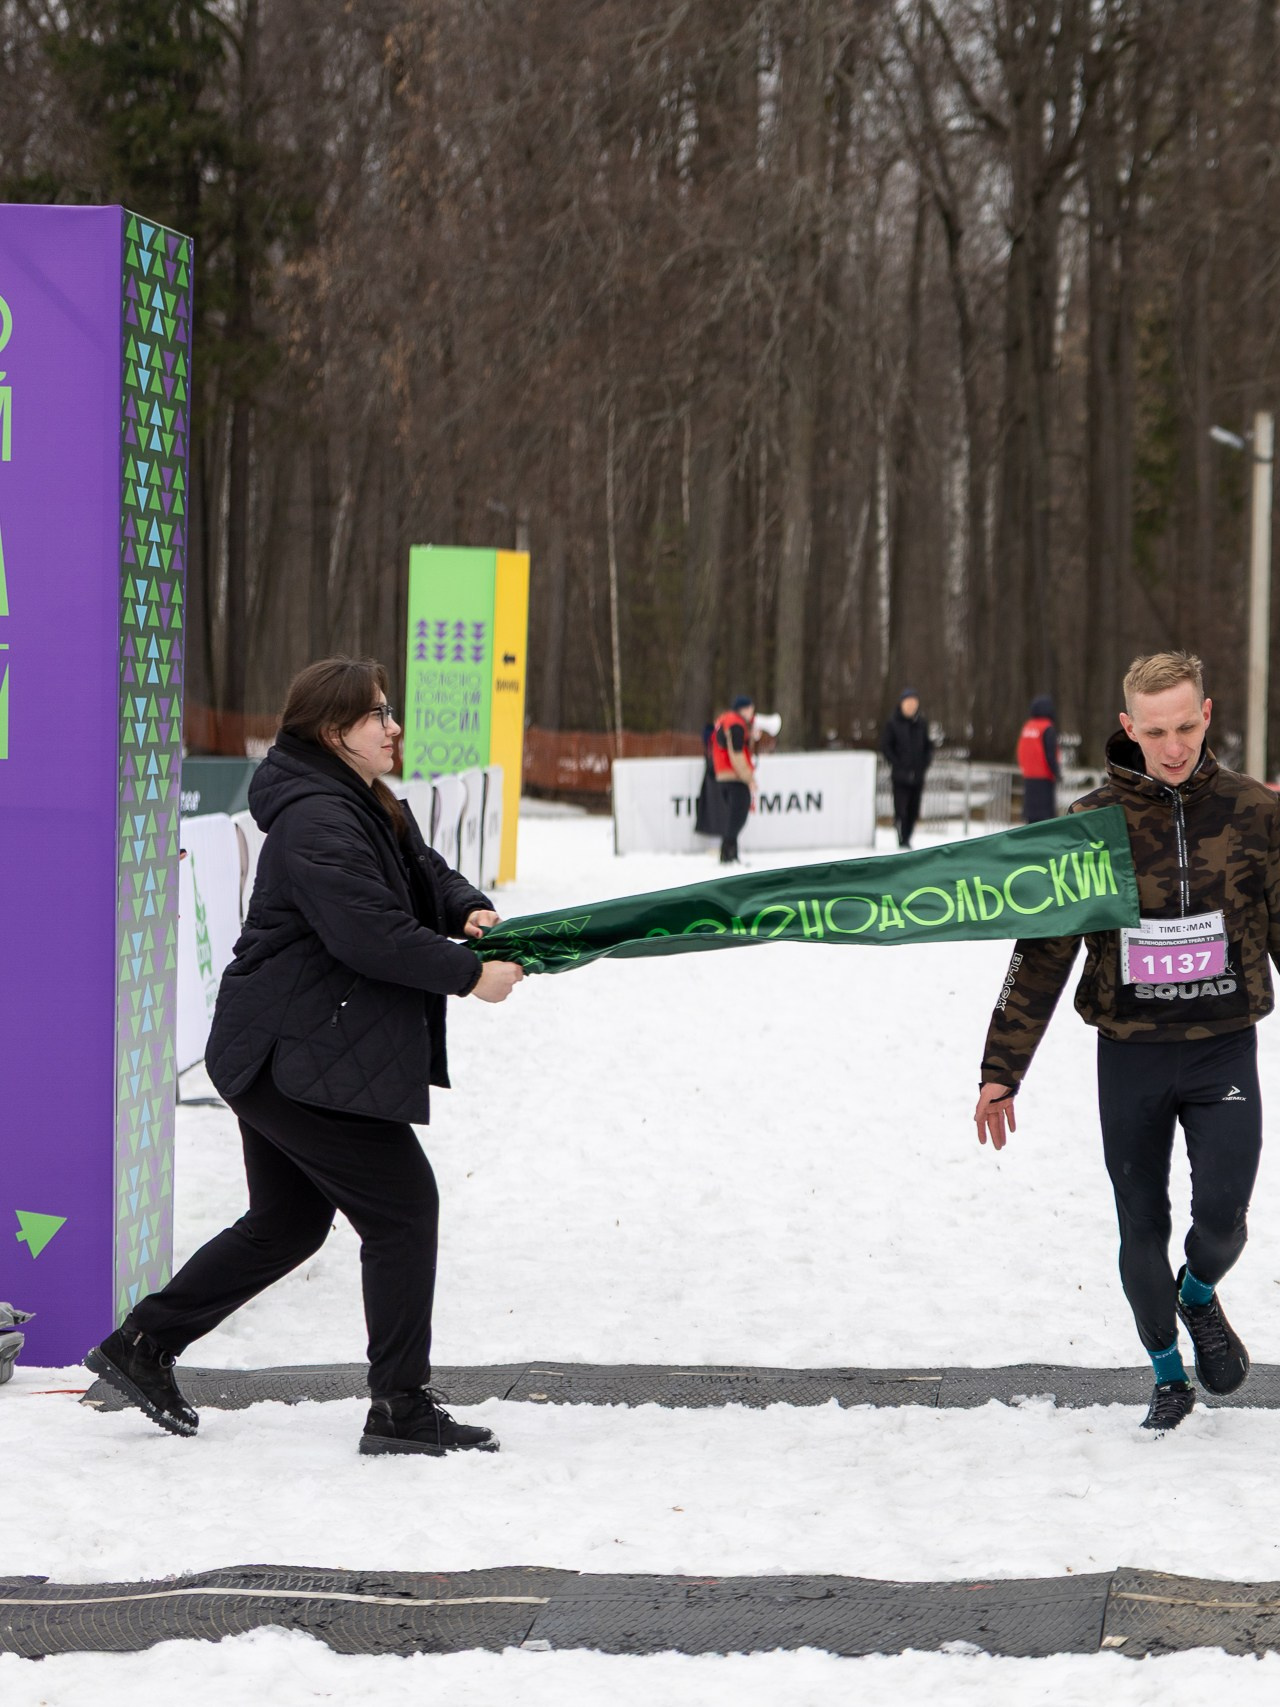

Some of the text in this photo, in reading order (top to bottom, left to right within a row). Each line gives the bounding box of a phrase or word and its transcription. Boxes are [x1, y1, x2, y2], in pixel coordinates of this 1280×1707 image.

[413, 740, 481, 767] 2026
[1142, 951, 1212, 975] 1137
[996, 952, 1024, 1012] BLACK
[1134, 979, 1237, 1001] SQUAD
